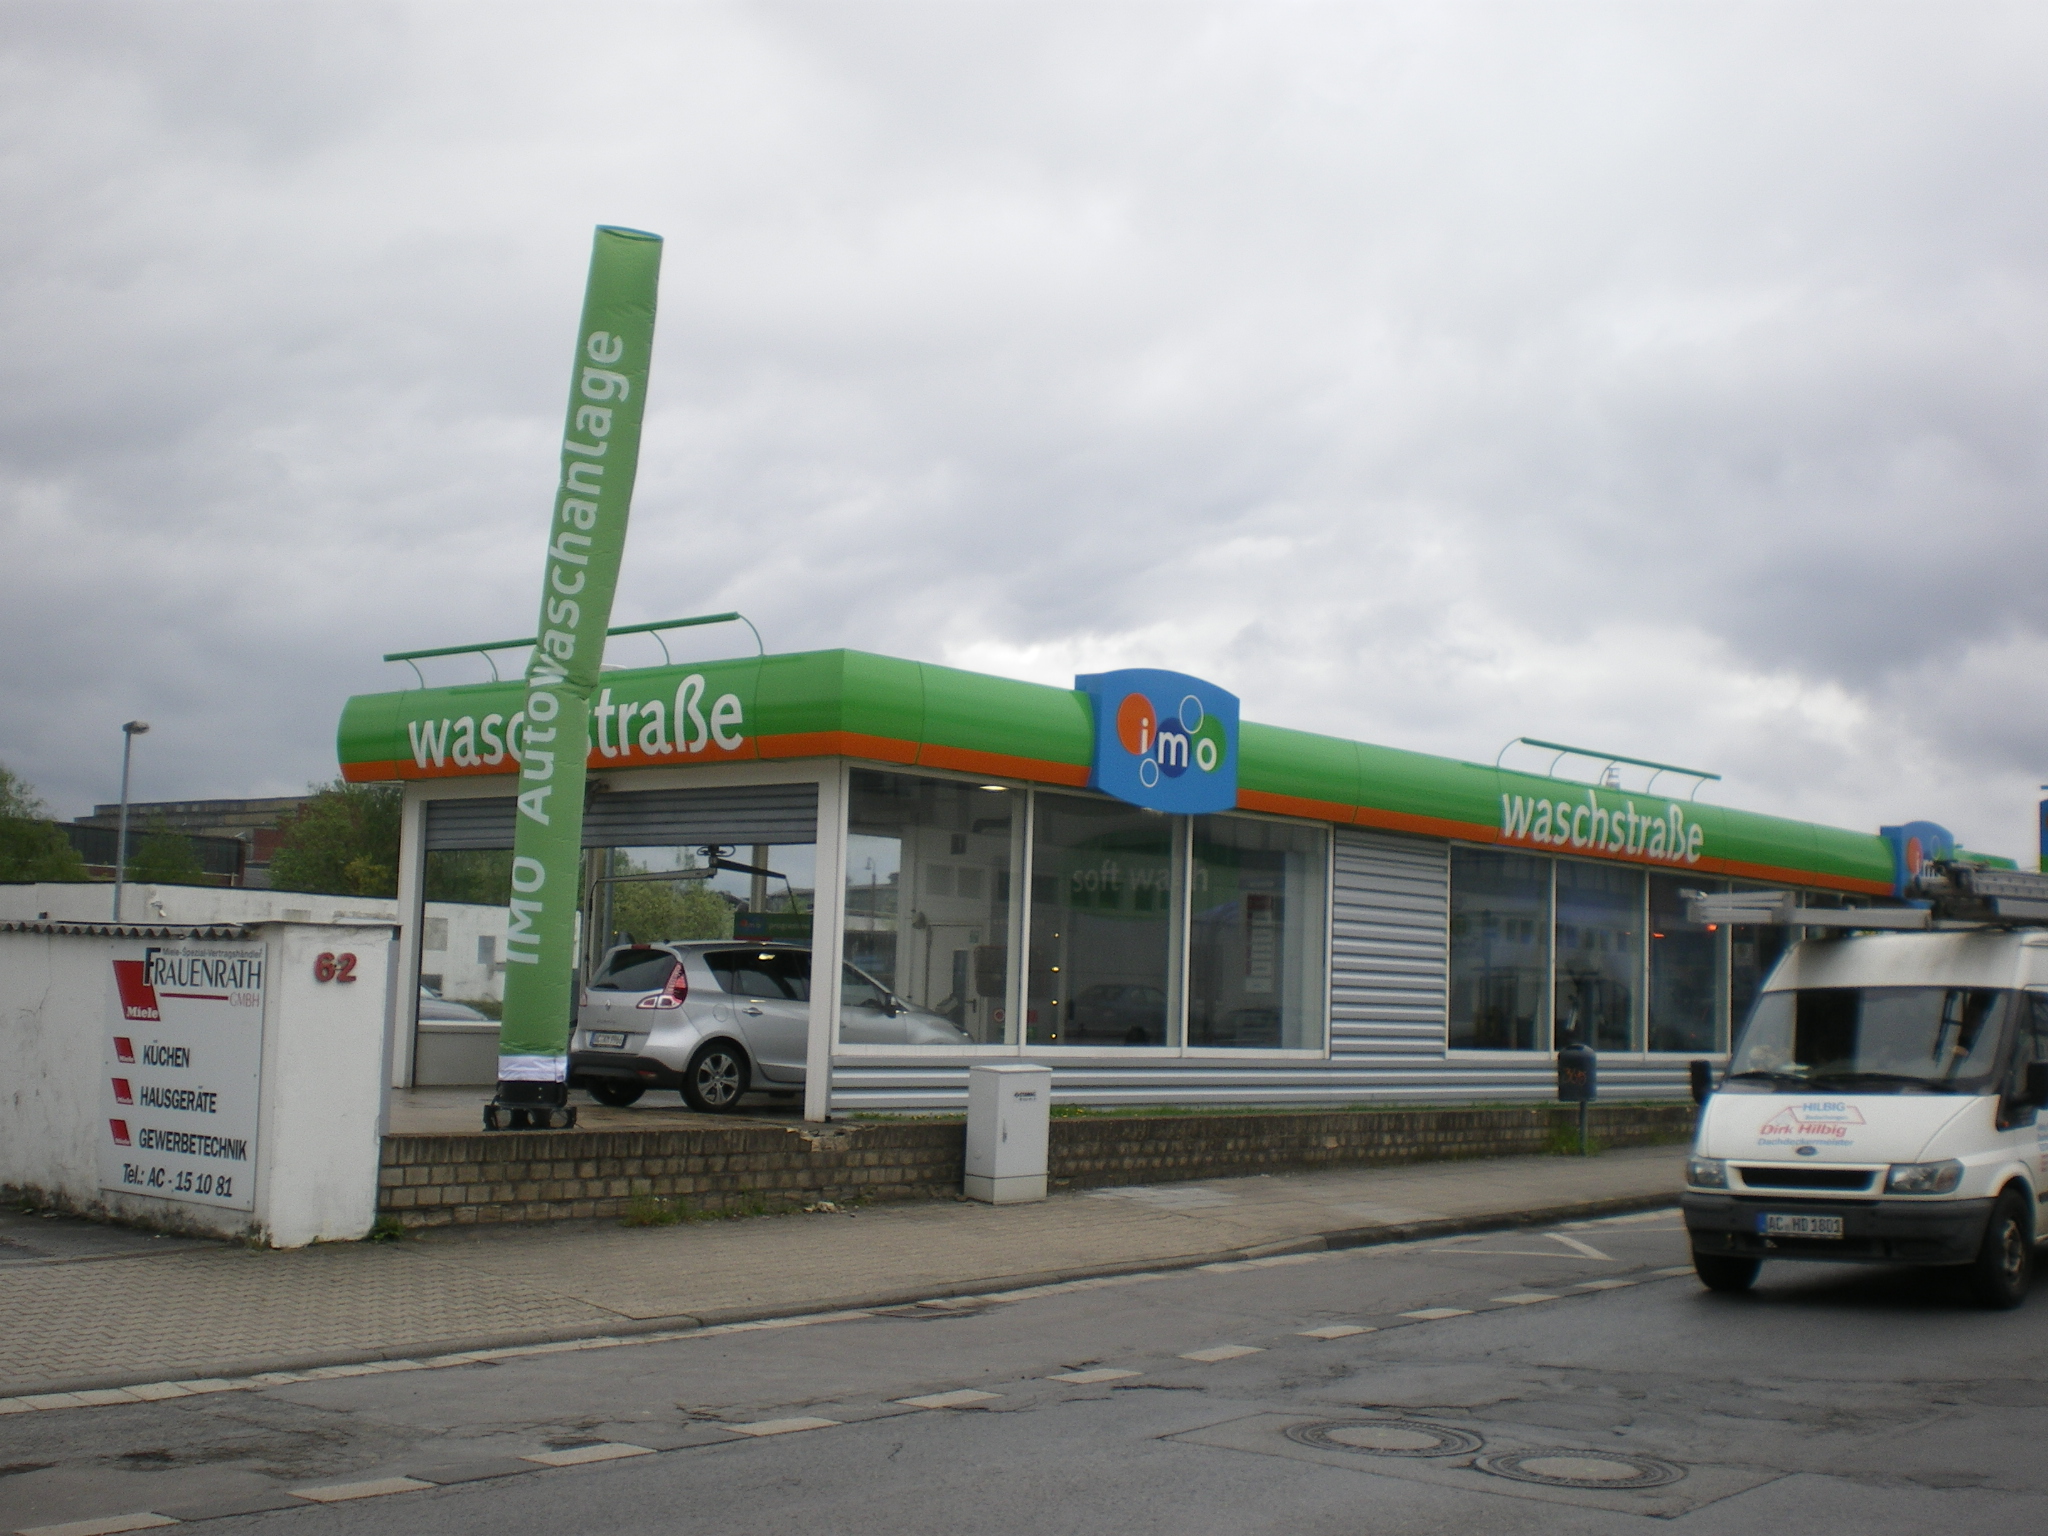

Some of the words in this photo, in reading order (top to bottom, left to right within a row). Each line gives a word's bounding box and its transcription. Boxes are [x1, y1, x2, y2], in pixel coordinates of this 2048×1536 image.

[408, 673, 744, 769] wasctraße
[1140, 717, 1217, 771] imo
[1502, 788, 1704, 864] waschstraße
[507, 856, 546, 965] IMO
[144, 947, 262, 990] FRAUENRATH
[314, 951, 358, 983] 62
[126, 1005, 159, 1020] Miele
[142, 1039, 191, 1069] KÜCHEN
[140, 1085, 217, 1114] HAUSGERÄTE
[1802, 1102, 1846, 1113] HILBIG
[138, 1128, 248, 1162] GEWERBETECHNIK
[1760, 1124, 1792, 1136] Dirk
[1797, 1123, 1848, 1138] Hilbig
[122, 1163, 145, 1186] Tel.:
[147, 1166, 165, 1189] AC
[174, 1171, 193, 1193] 15
[195, 1173, 213, 1195] 10
[215, 1175, 233, 1198] 81
